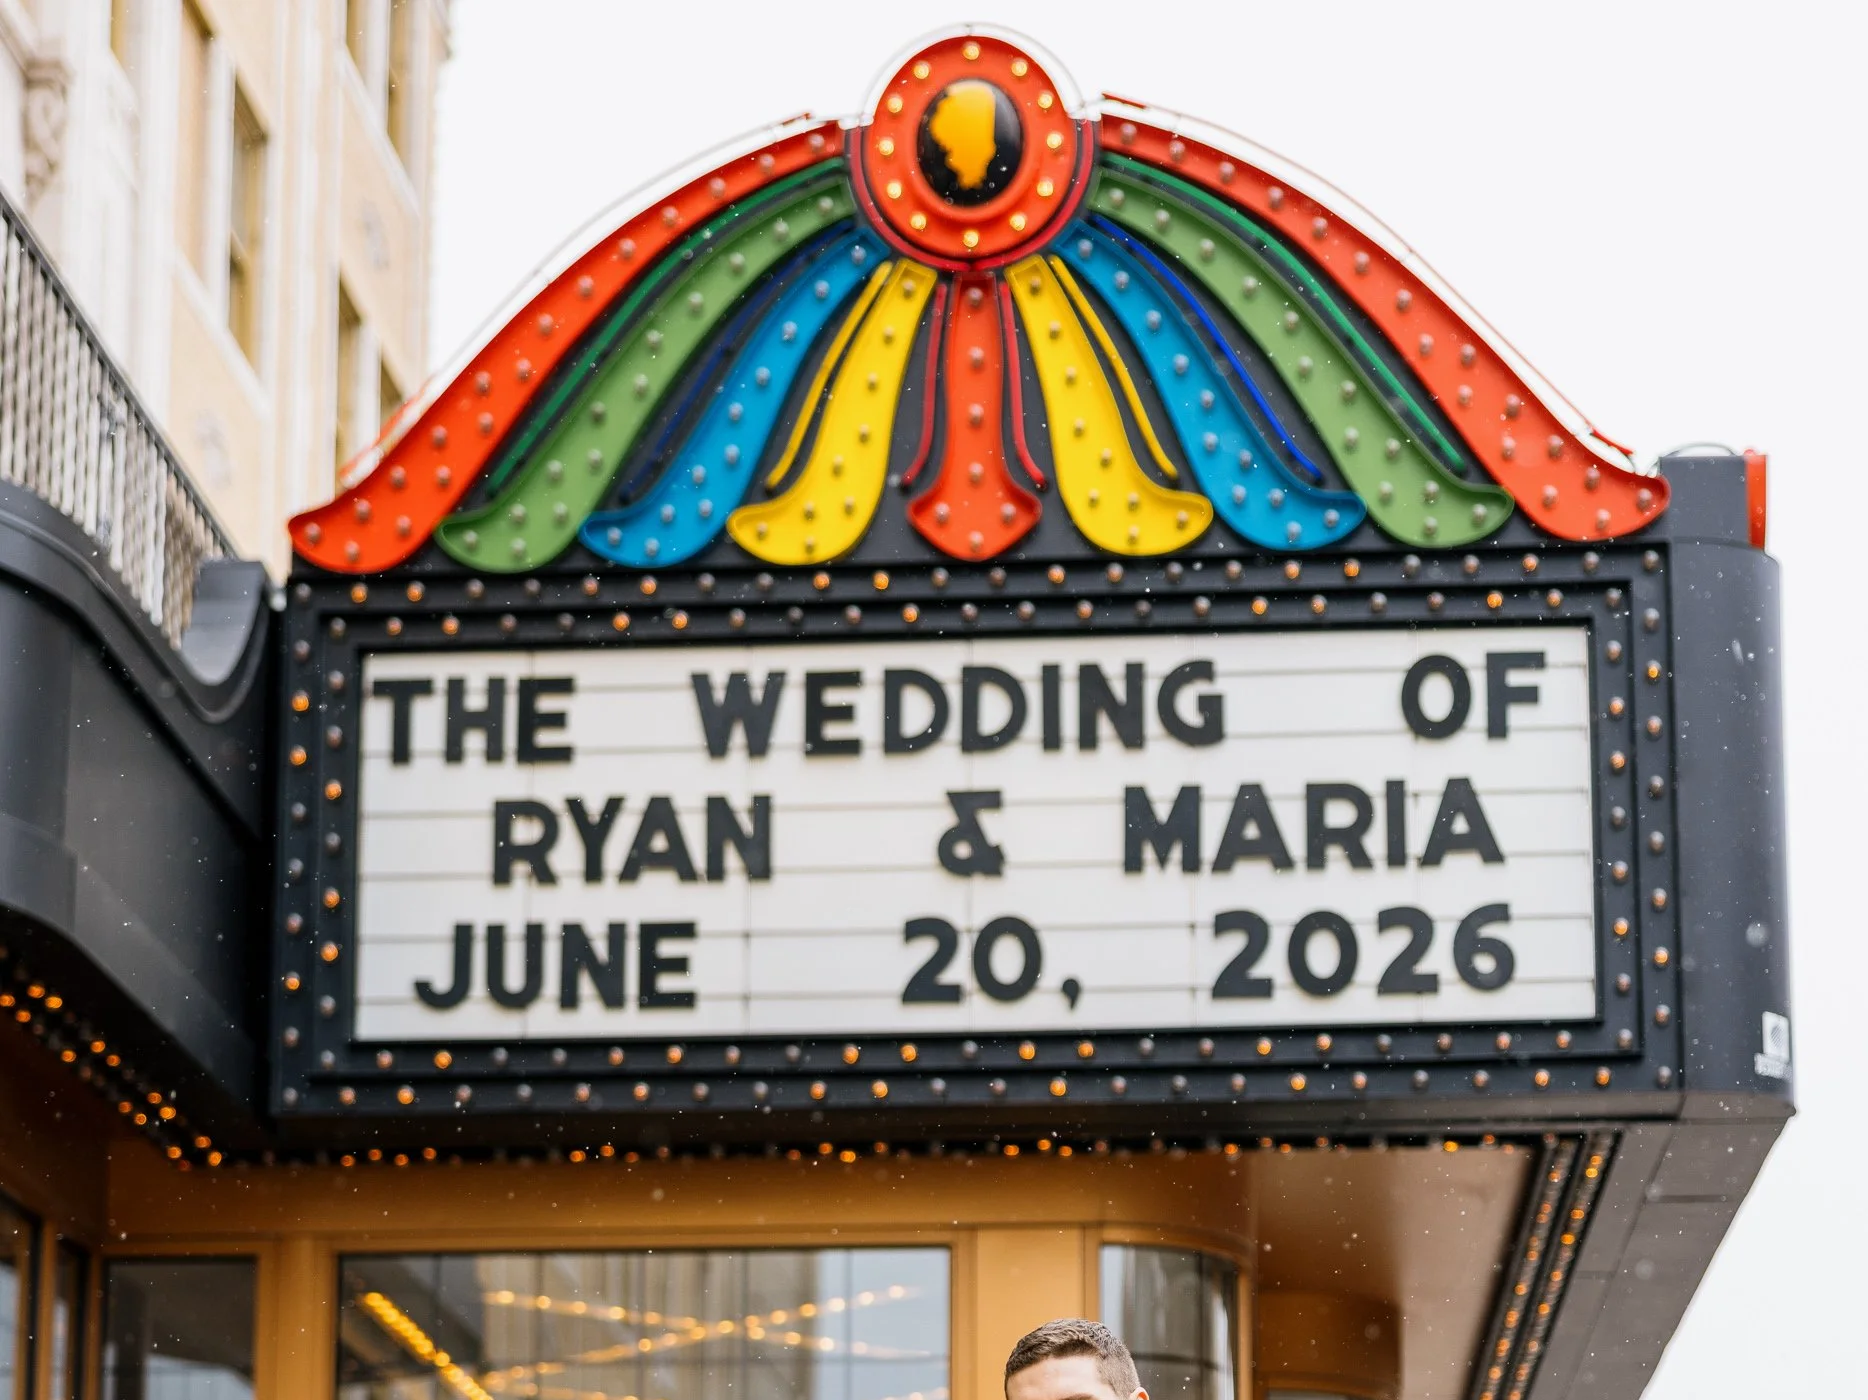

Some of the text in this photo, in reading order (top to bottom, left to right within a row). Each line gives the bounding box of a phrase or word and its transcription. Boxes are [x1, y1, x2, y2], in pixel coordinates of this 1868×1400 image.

[371, 651, 1546, 767] THE WEDDING OF
[491, 777, 1505, 886] RYAN & MARIA
[413, 903, 1515, 1012] JUNE 20, 2026
